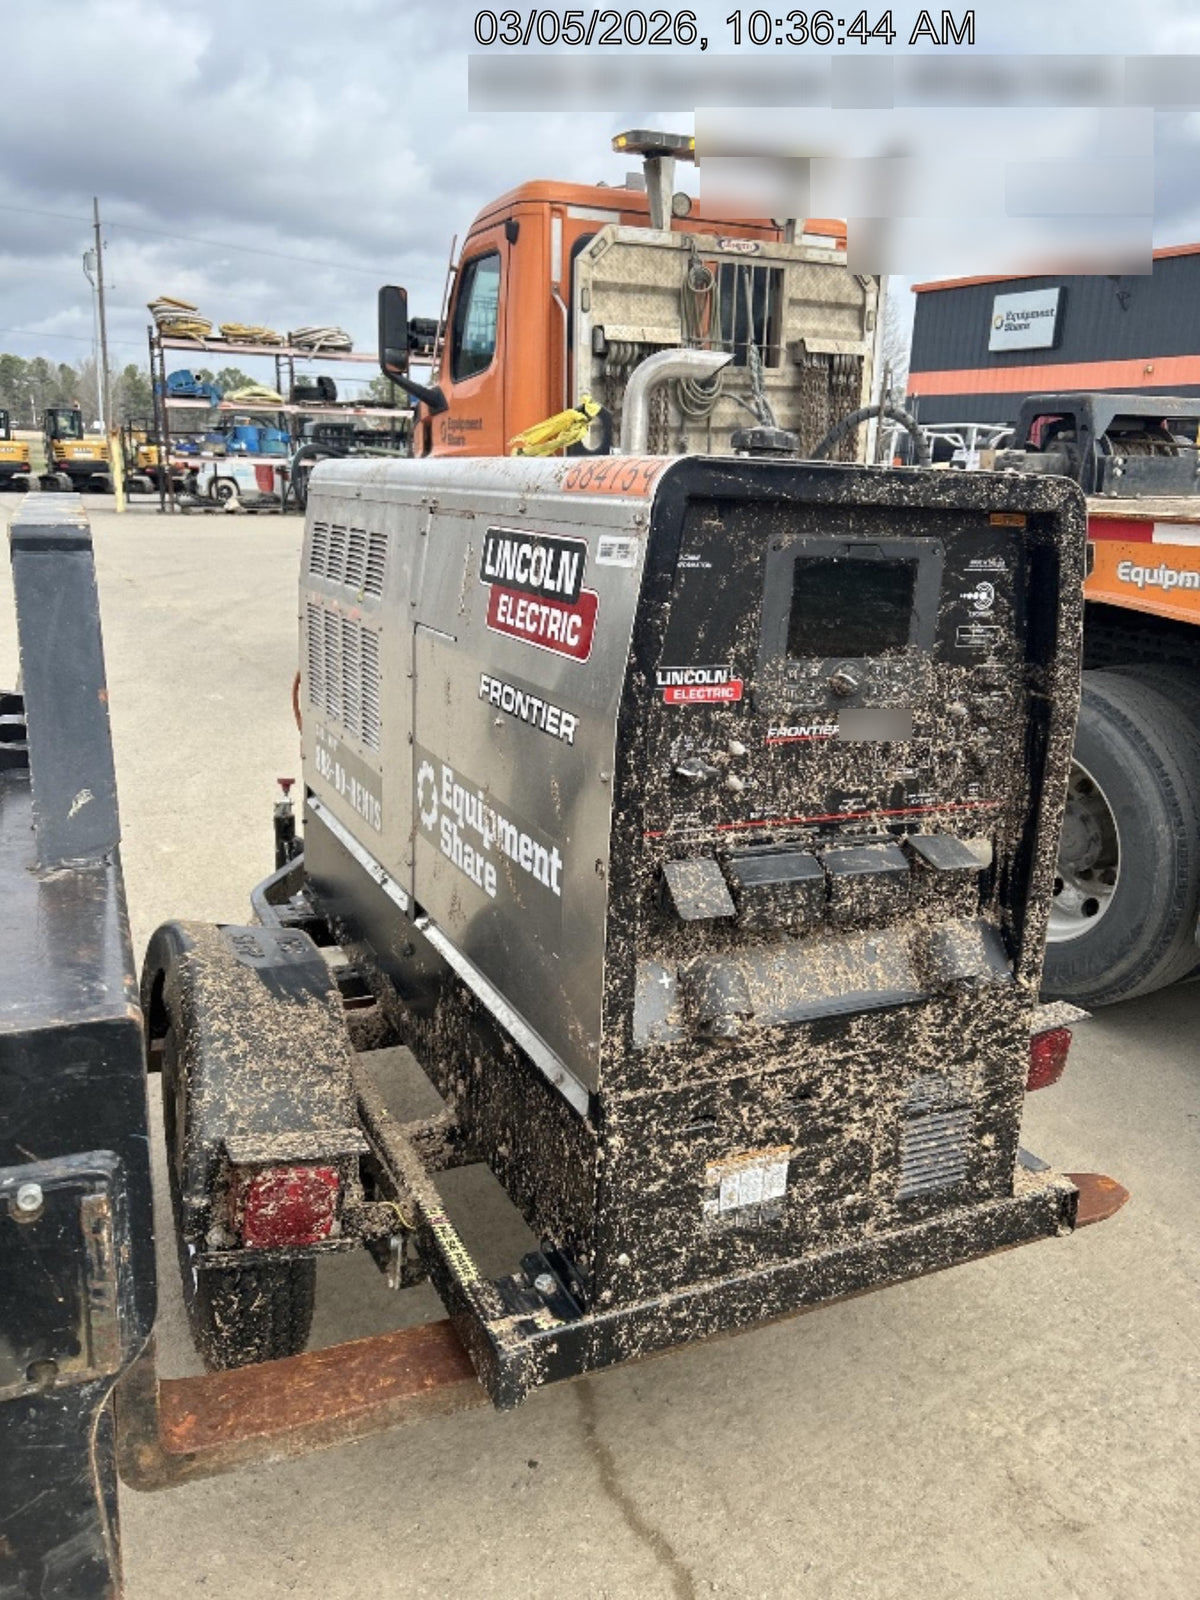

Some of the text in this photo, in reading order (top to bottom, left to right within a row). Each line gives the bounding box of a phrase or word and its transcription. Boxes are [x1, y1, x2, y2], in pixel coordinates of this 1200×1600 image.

[484, 537, 580, 596] LINCOLN
[496, 593, 583, 647] ELECTRIC
[655, 669, 728, 686] LINCOLN
[672, 687, 735, 701] ELECTRIC
[478, 672, 579, 747] FRONTIER
[440, 763, 564, 898] Equipment
[440, 813, 498, 899] Share
